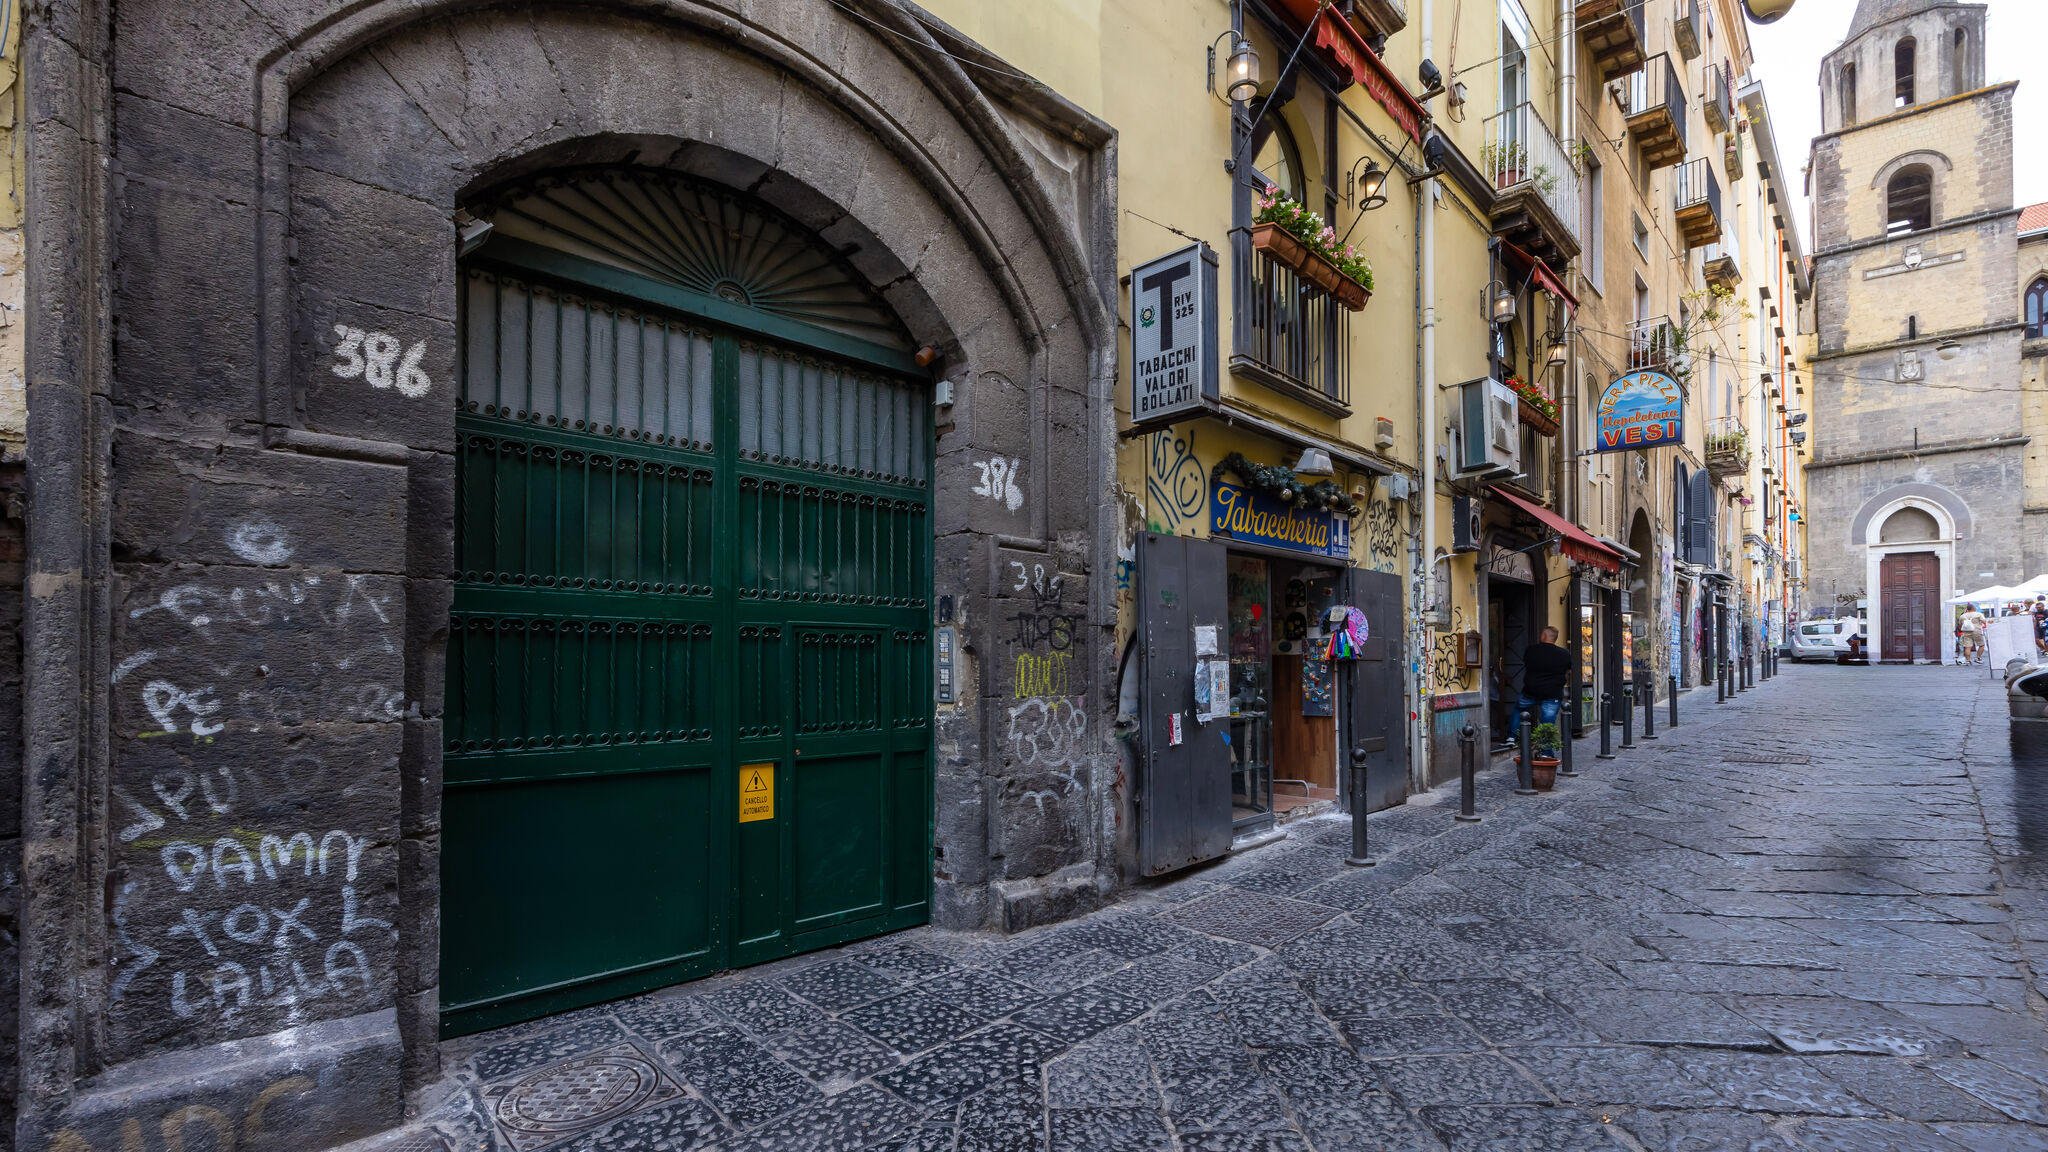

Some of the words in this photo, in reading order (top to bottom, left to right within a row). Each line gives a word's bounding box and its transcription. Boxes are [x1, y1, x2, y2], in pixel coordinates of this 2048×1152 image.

[1142, 260, 1191, 352] T
[1174, 291, 1192, 308] RIV
[1175, 303, 1194, 320] 325
[331, 324, 431, 398] 386
[1139, 345, 1196, 377] TABACCHI
[1145, 366, 1189, 394] VALORI
[1141, 384, 1193, 412] BOLLATI
[1600, 378, 1634, 417] VERA
[1639, 373, 1679, 406] PIZZA
[1602, 409, 1680, 429] Napoletana
[1602, 420, 1676, 447] VESI
[971, 456, 1024, 513] 386
[1216, 486, 1329, 548] Tabaccheria
[745, 795, 768, 805] CANCELLO
